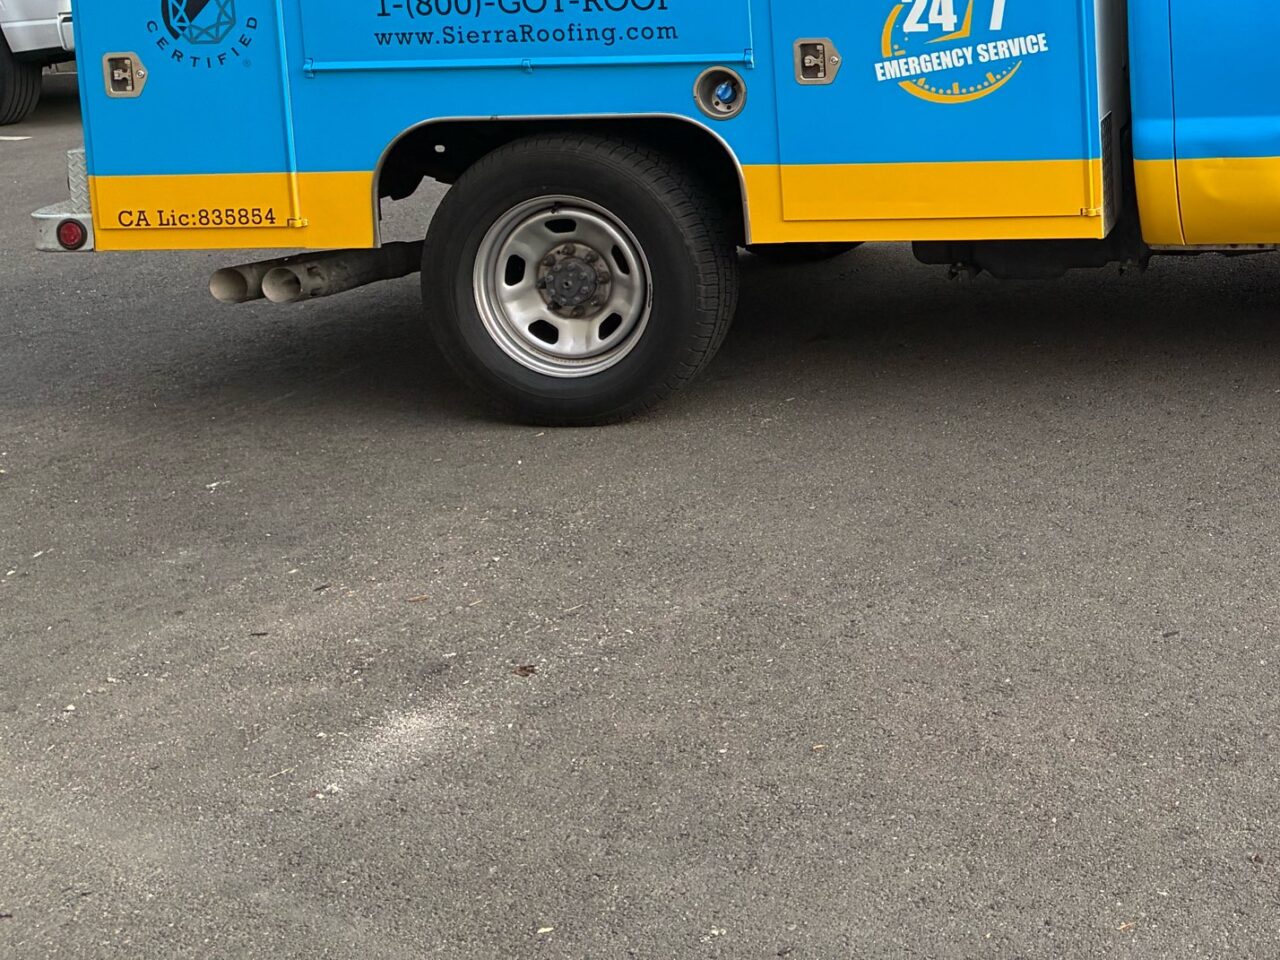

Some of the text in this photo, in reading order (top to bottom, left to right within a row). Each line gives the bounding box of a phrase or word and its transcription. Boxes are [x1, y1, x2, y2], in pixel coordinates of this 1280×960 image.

[146, 17, 258, 69] CERTIFIED
[374, 23, 679, 46] www.SierraRoofing.com
[874, 33, 1049, 82] EMERGENCY SERVICE
[118, 208, 276, 227] CA Lic:835854
